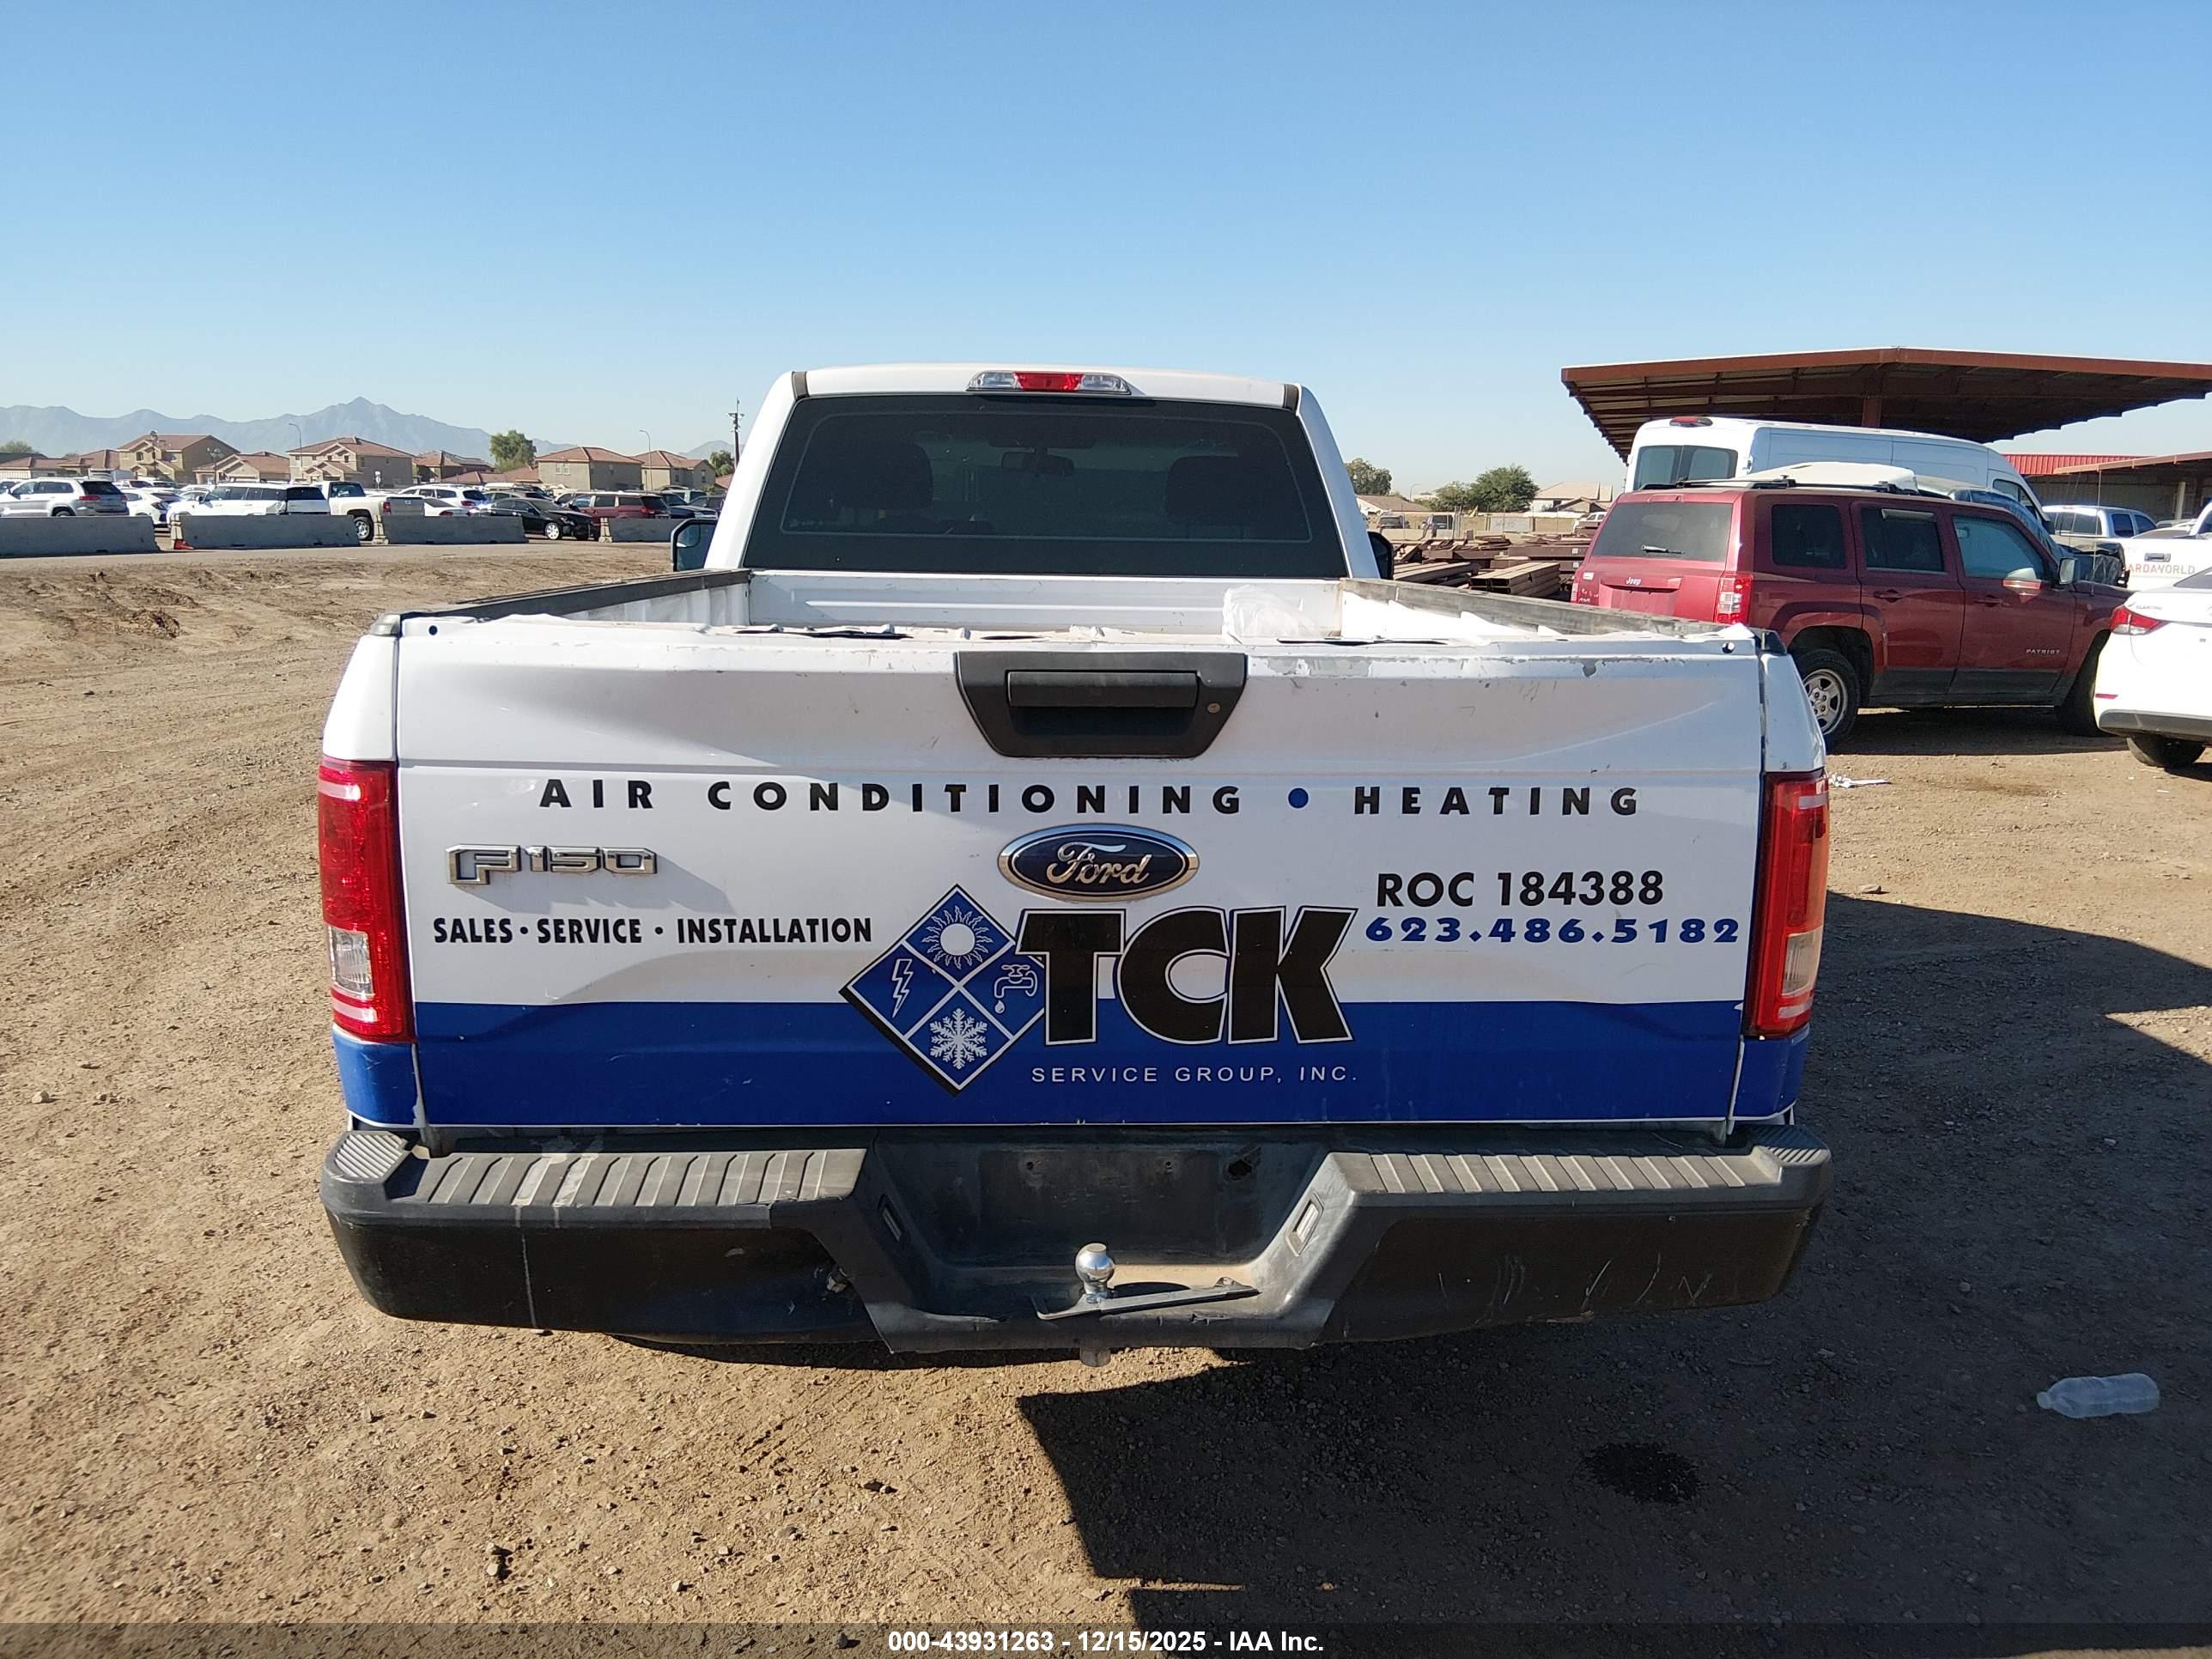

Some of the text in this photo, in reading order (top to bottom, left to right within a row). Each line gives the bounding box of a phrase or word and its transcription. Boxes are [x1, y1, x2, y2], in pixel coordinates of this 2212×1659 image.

[1626, 577, 1641, 586] Jeep
[2126, 563, 2196, 574] ARDAWORLD
[539, 778, 1637, 816] AIR CONDITIONING HEATING
[1046, 841, 1153, 885] Ford
[1376, 870, 1664, 908] ROC 184388
[678, 917, 872, 943] INSTALLATION
[1365, 916, 1739, 944] 623.486.5182
[1015, 905, 1358, 1046] TCK
[1030, 1066, 1358, 1085] SERVICE GROUP, INC.
